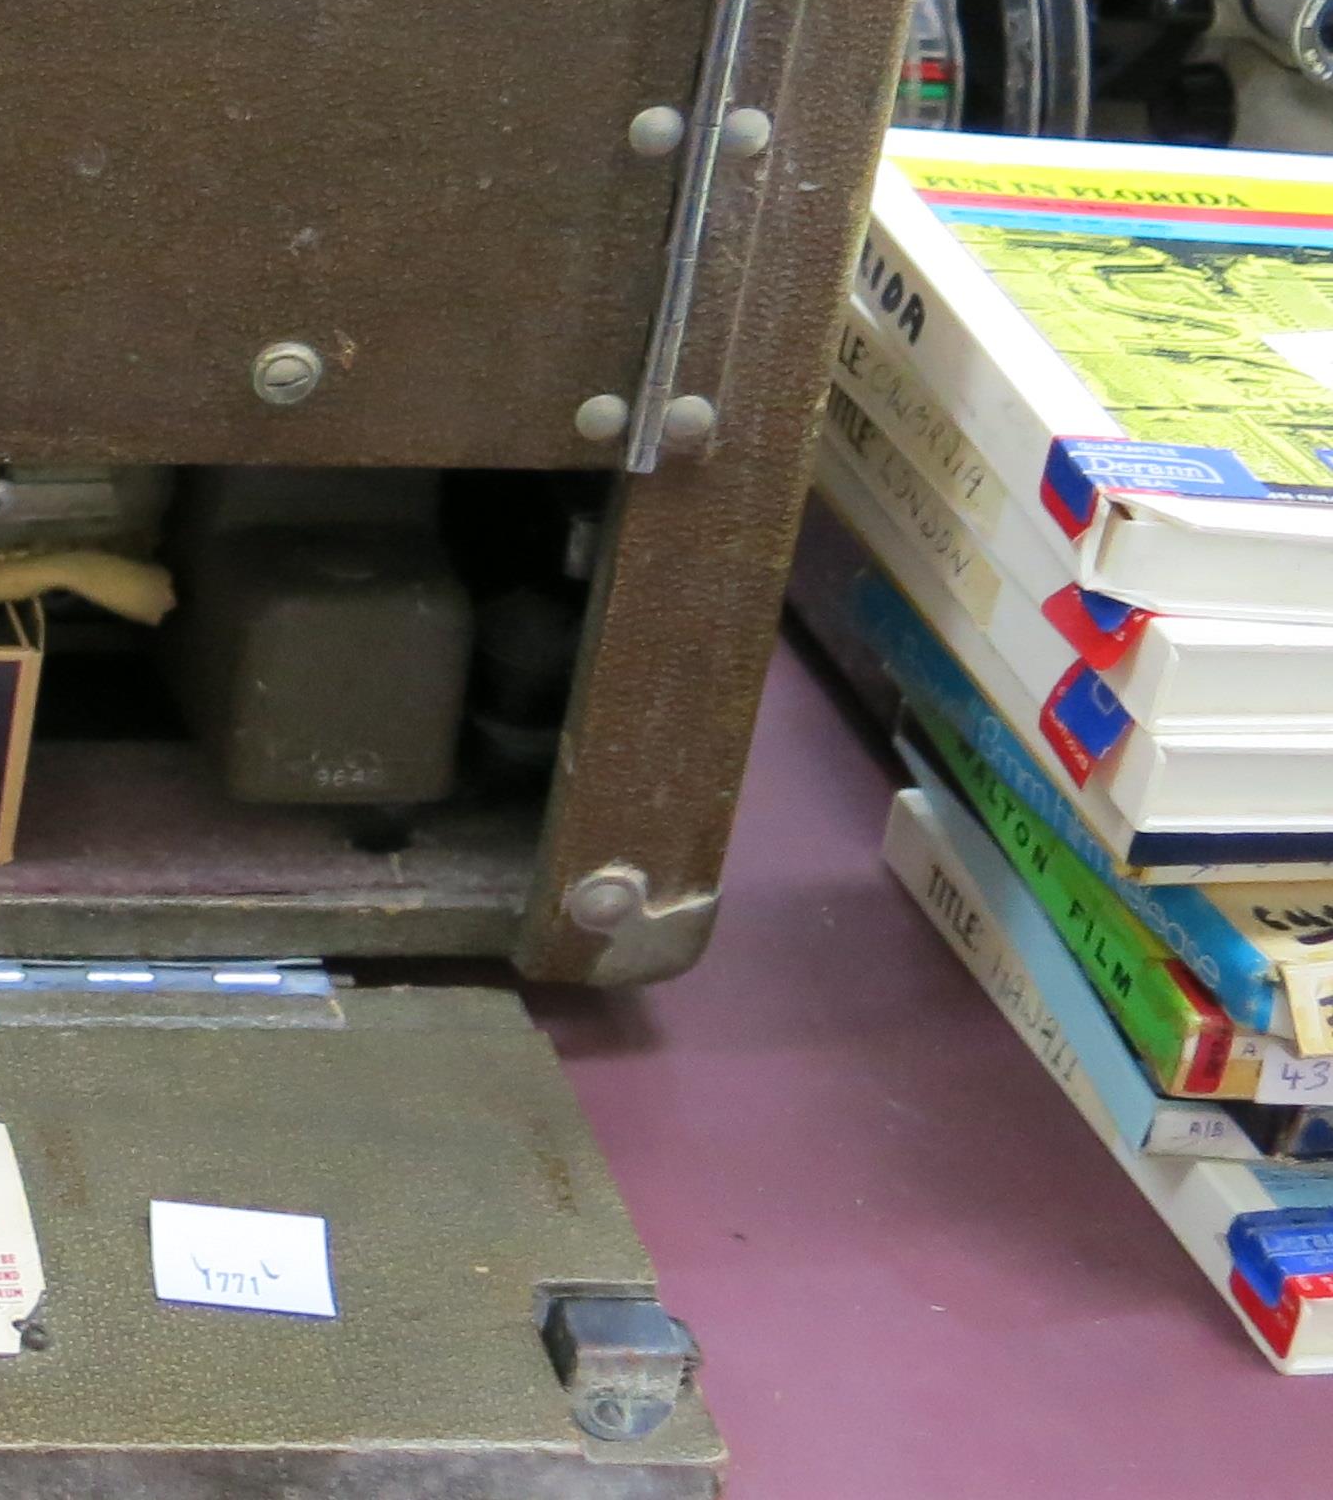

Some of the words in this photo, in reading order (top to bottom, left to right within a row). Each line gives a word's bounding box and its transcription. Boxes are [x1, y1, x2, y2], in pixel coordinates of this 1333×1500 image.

[1069, 184, 1250, 208] FLORIDA
[1089, 456, 1205, 479] Derann
[1067, 899, 1134, 999] FILM
